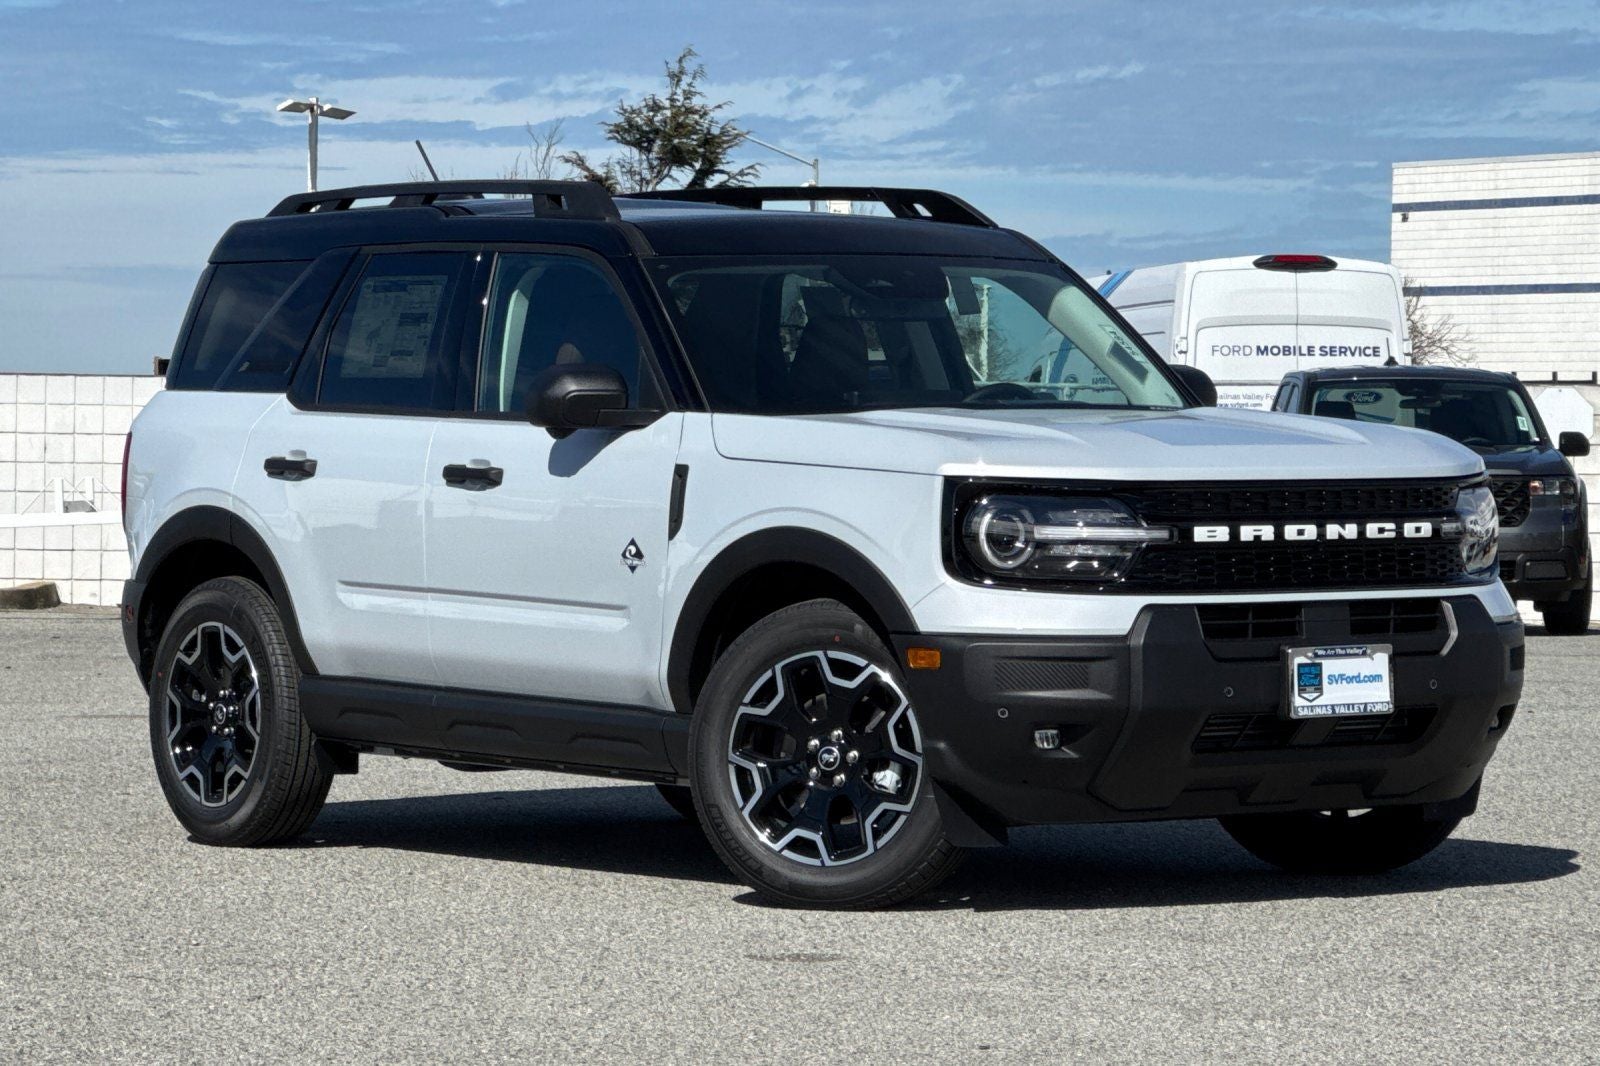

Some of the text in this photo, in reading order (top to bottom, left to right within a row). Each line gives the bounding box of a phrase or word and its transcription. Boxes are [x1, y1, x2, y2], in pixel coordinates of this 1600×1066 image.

[1211, 345, 1381, 358] FORD MOBILE SERVICE
[1242, 392, 1264, 401] Valley
[1193, 522, 1433, 542] BRONCO
[1327, 672, 1384, 685] SVFord.com
[1297, 702, 1389, 716] SALINAS VALLEY FORD
